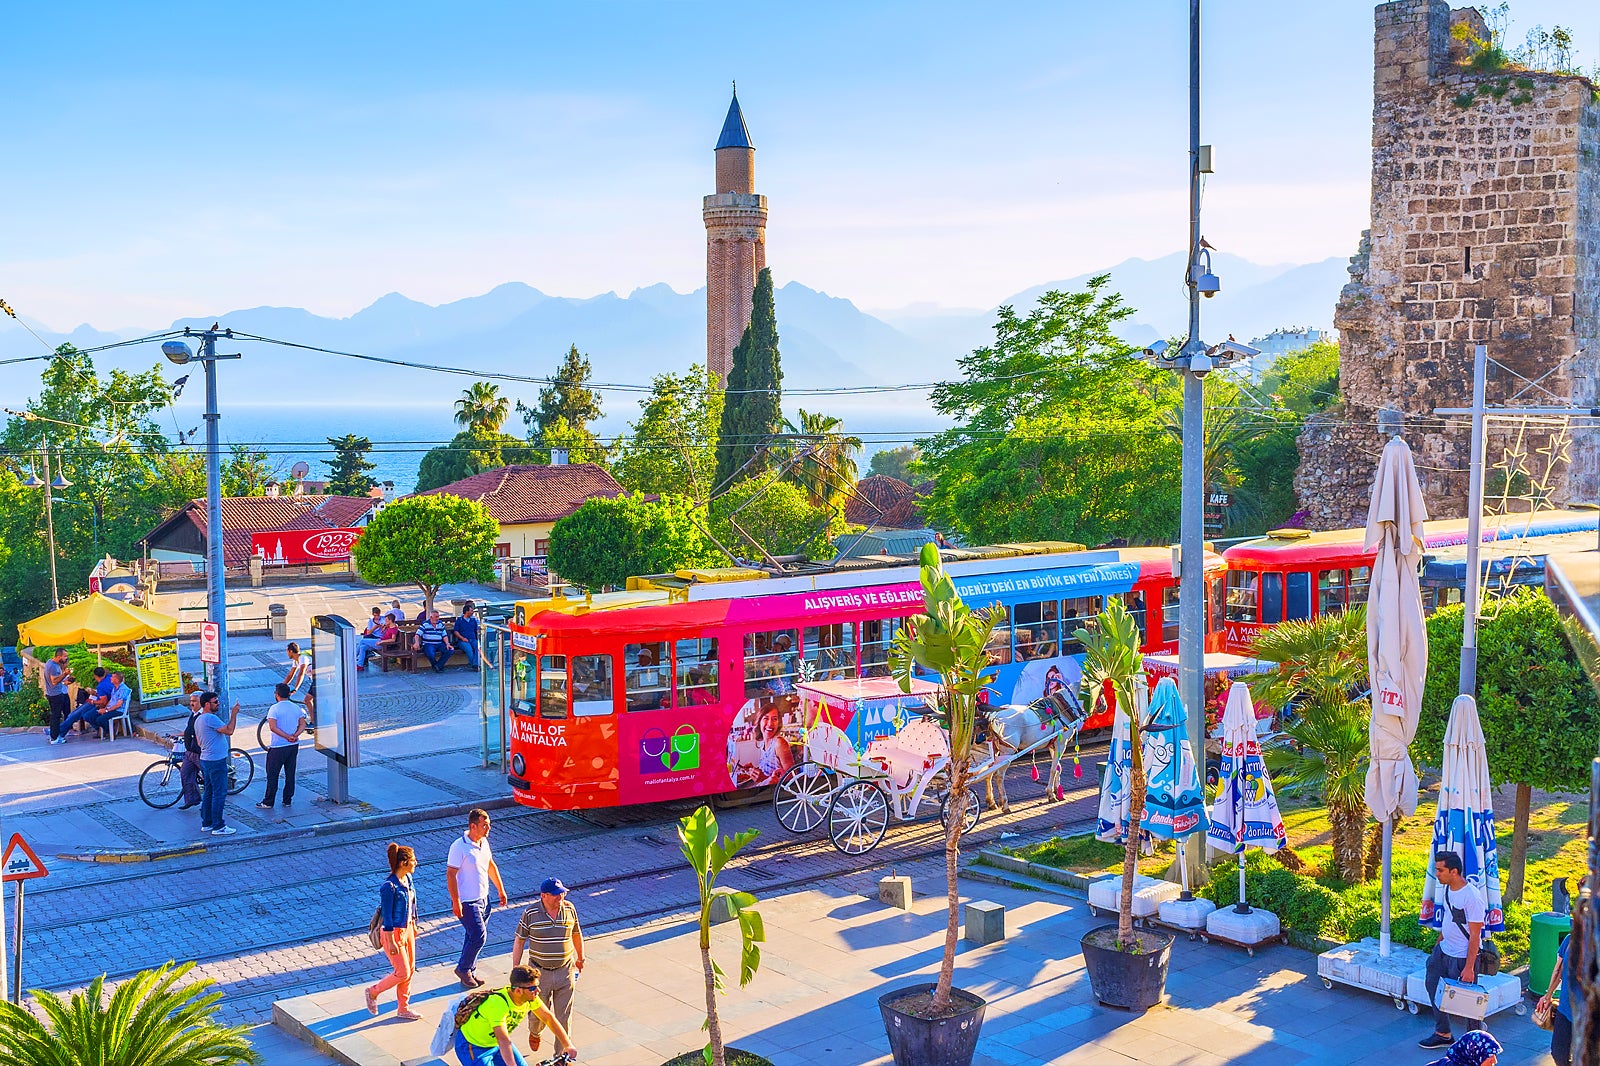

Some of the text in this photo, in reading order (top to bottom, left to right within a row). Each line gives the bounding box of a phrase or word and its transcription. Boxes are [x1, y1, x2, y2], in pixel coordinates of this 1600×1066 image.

[1210, 494, 1228, 503] KAFE
[317, 534, 353, 548] 1923
[804, 593, 862, 609] ALIŞVERİŞ
[862, 593, 878, 604] VE
[956, 579, 1015, 597] KDENİZ'DEKİ
[1016, 579, 1030, 590] EN
[1030, 574, 1063, 589] BÜYÜK
[1063, 575, 1076, 585] EN
[1076, 569, 1100, 584] YENİ
[1100, 567, 1132, 582] ADRESİ
[521, 720, 545, 735] MALL
[547, 725, 566, 736] OF
[520, 731, 567, 747] ANTALYA
[1248, 824, 1273, 838] dondur
